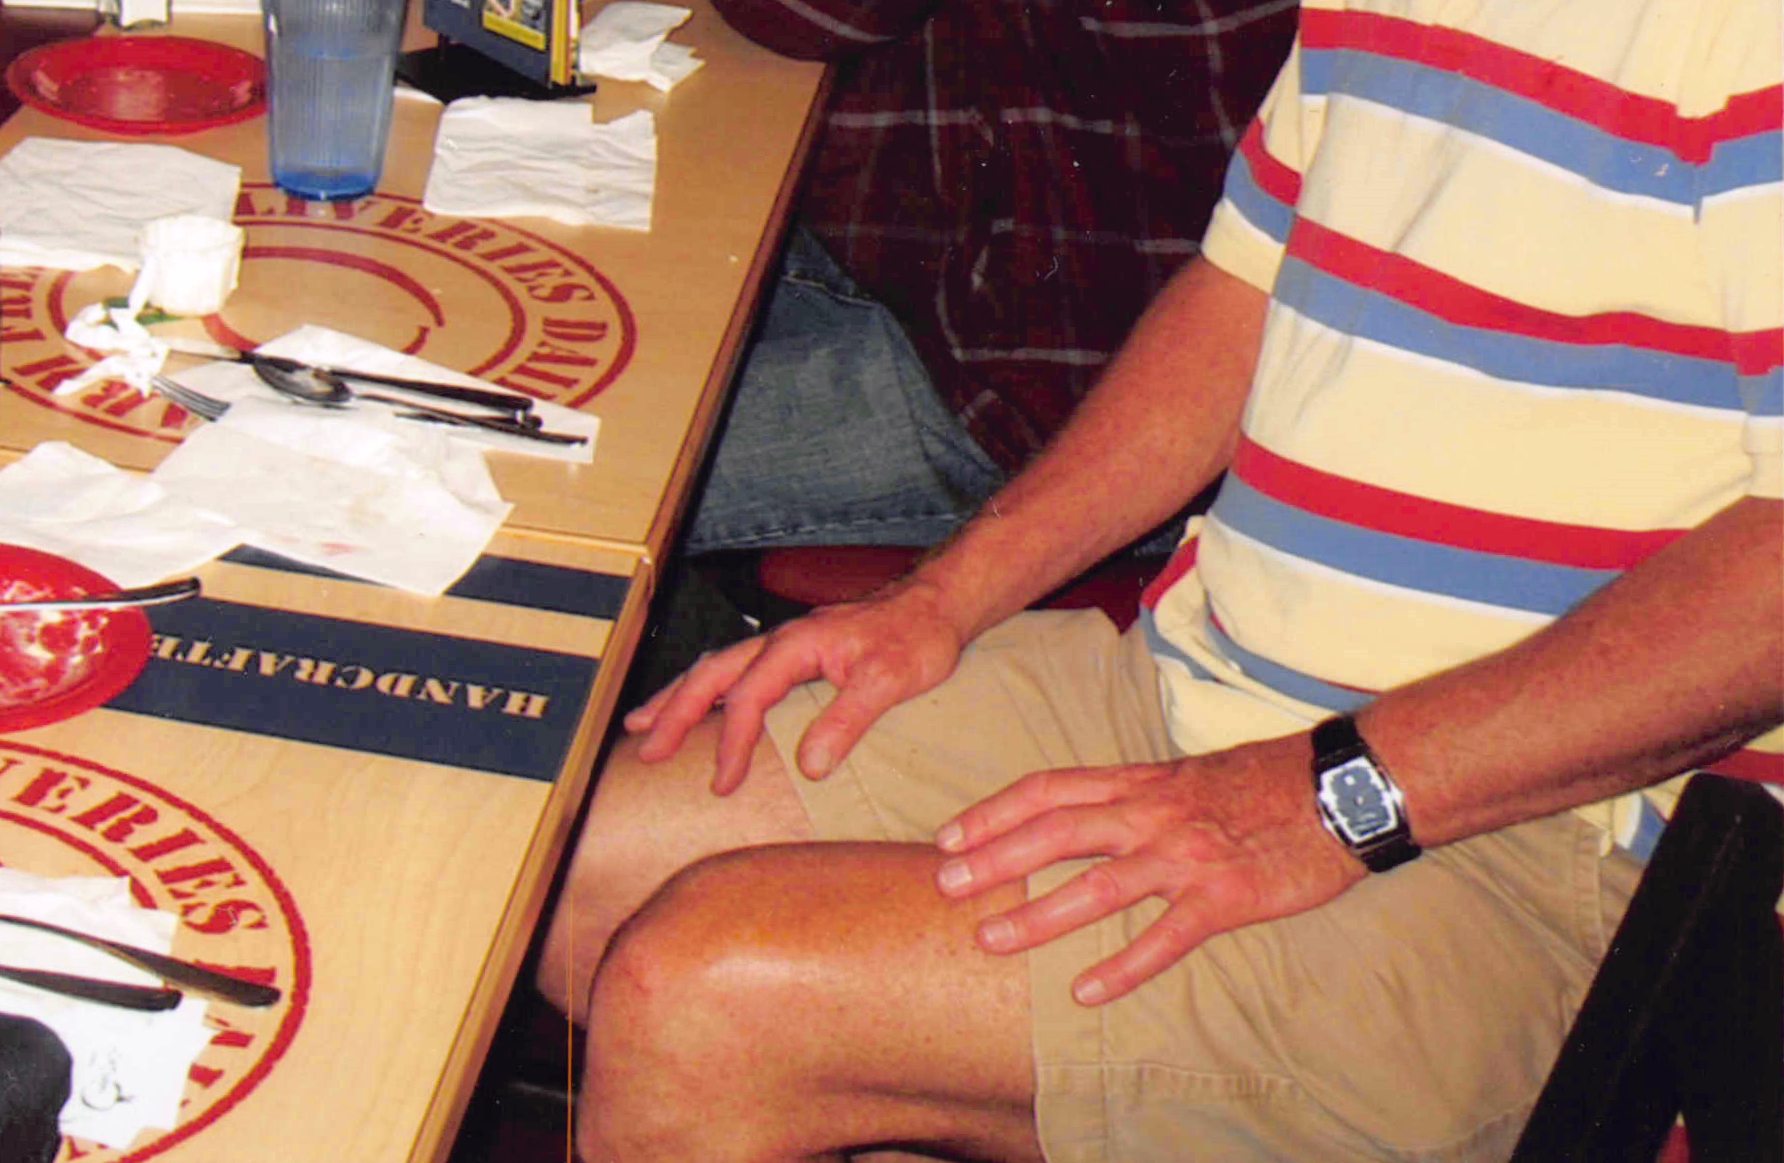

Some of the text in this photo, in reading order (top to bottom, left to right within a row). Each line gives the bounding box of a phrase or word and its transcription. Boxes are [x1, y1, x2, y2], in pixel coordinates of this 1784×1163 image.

[235, 192, 598, 304] LIVERIES
[494, 316, 609, 402] DAIL
[150, 634, 550, 719] HANDCRAFTE
